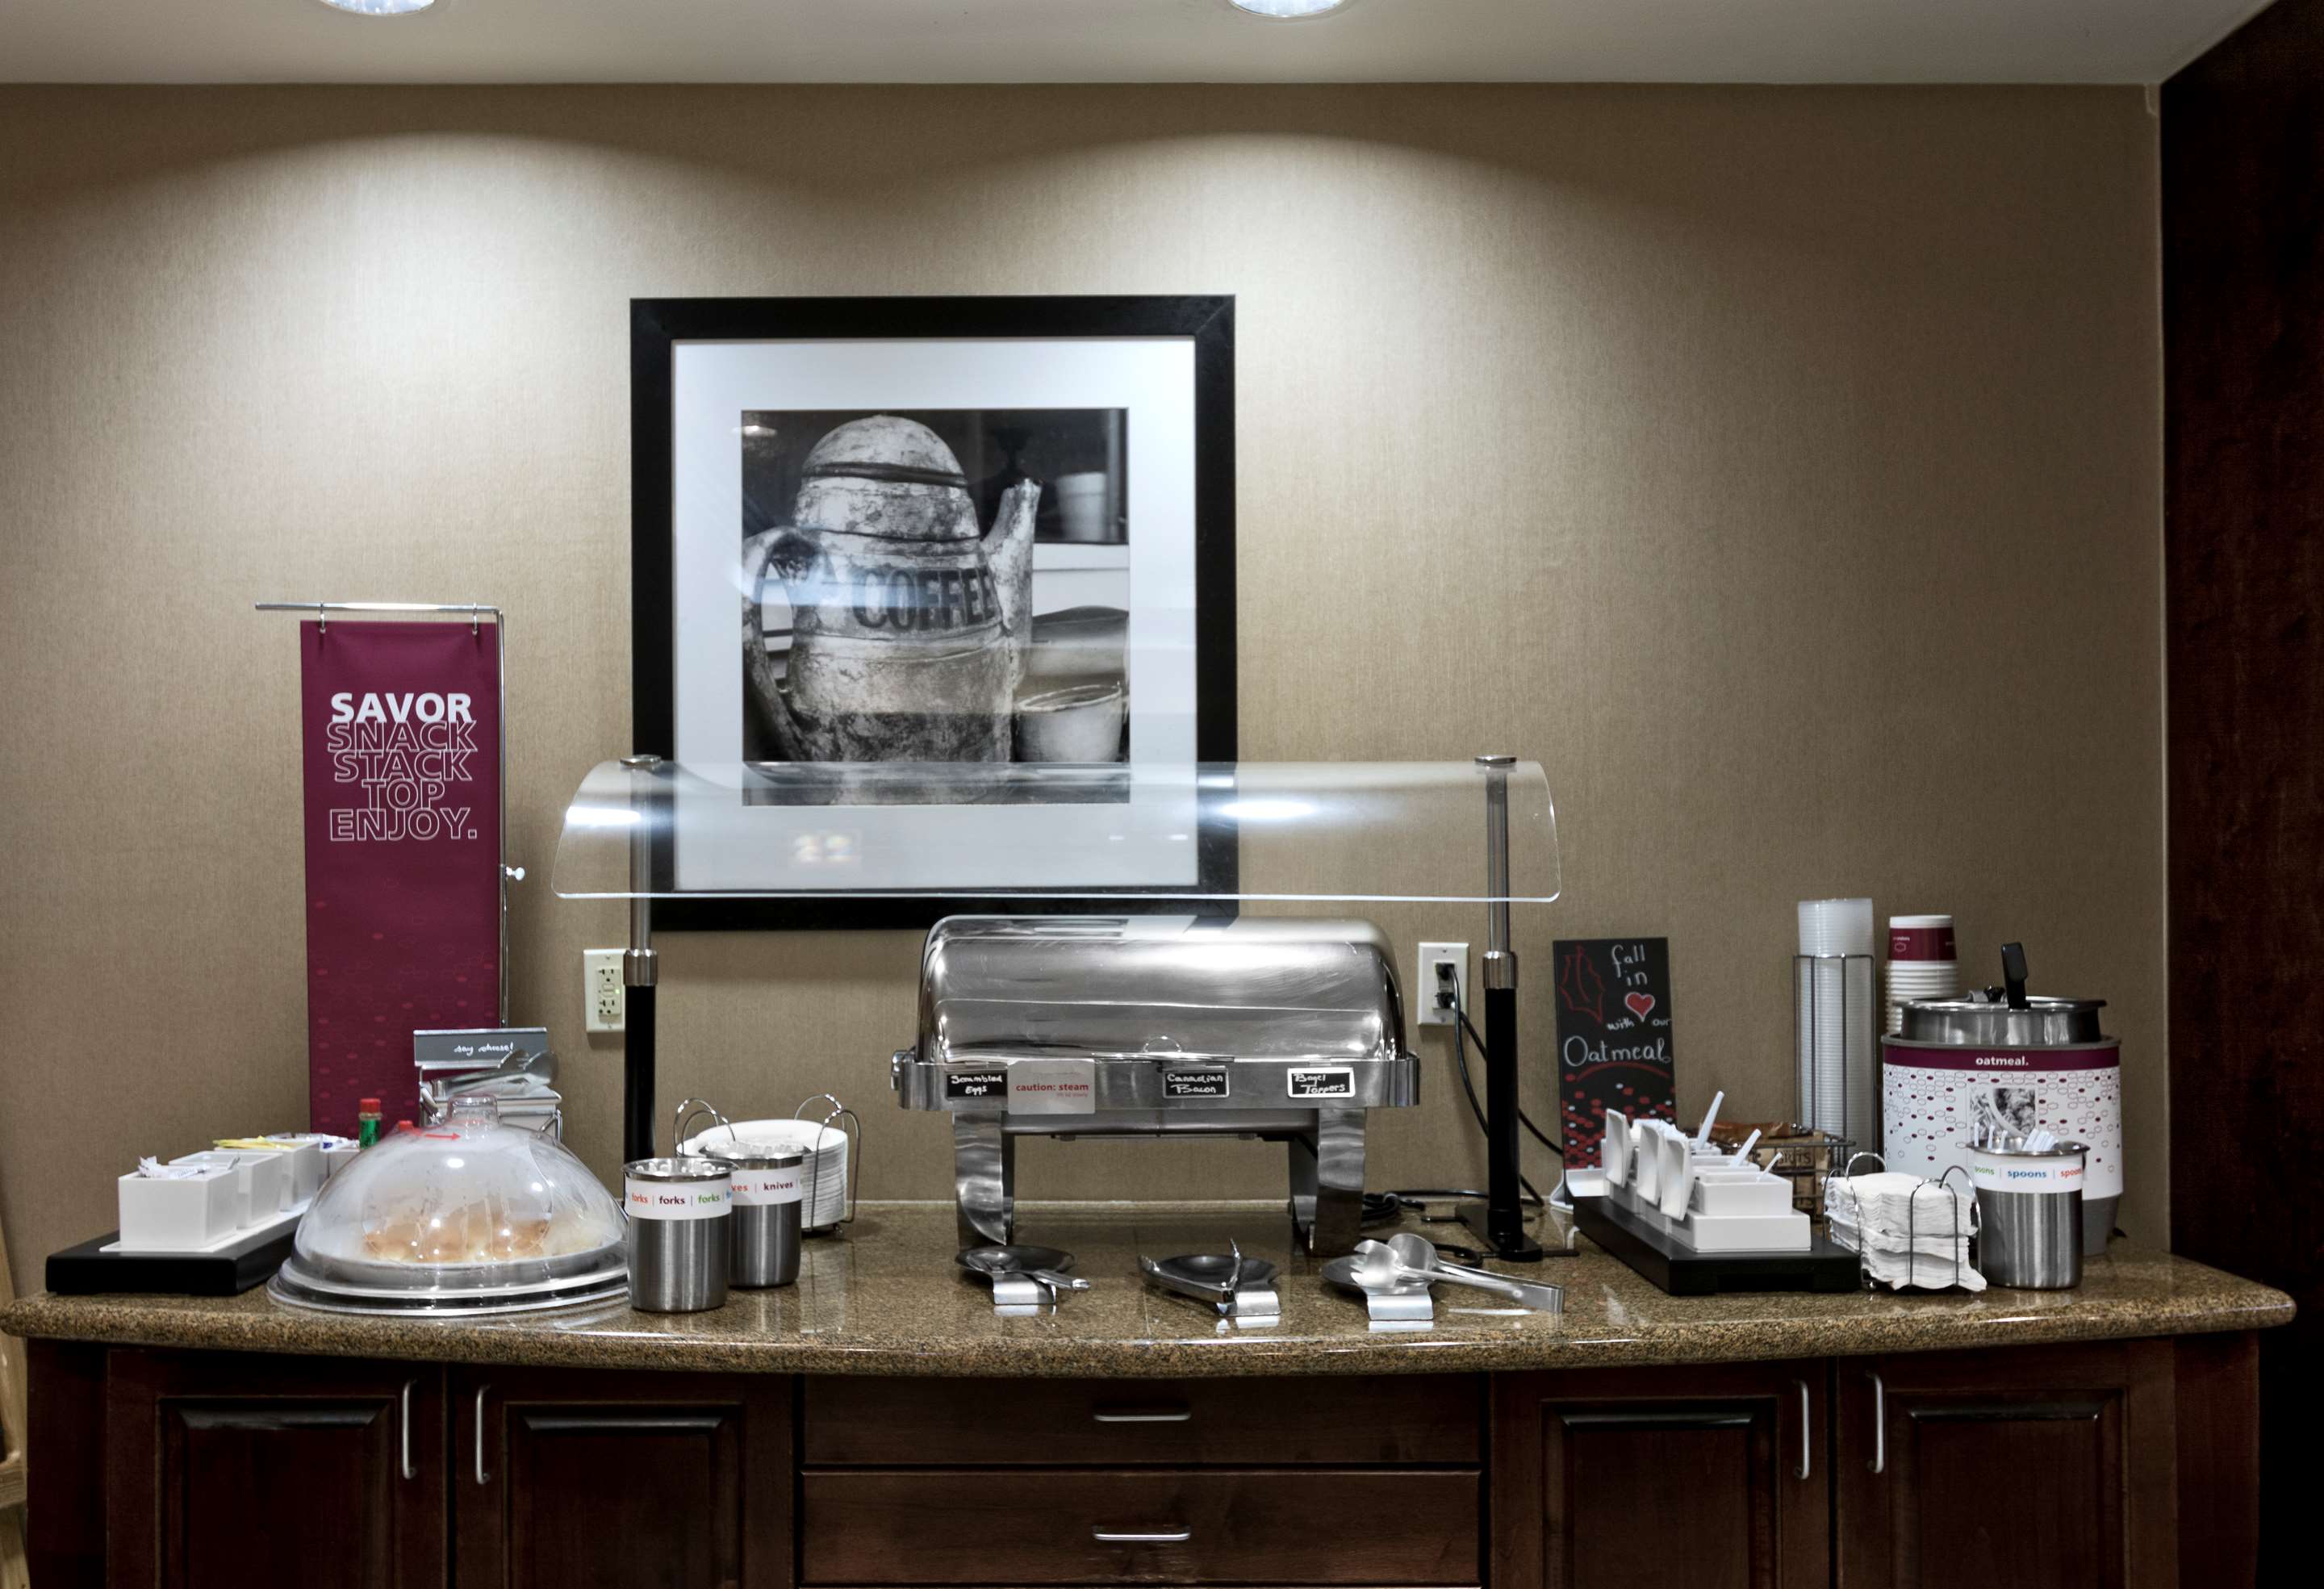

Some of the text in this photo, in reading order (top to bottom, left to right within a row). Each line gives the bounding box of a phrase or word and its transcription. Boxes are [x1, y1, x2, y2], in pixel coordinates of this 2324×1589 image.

[851, 563, 997, 630] COFFEE
[331, 692, 473, 724] SAVOR
[327, 720, 479, 753] SNACK
[333, 749, 473, 783] STACK
[362, 778, 445, 811] TOP
[329, 807, 478, 842] ENJOY.
[1611, 944, 1645, 977] fall
[1626, 970, 1648, 986] in
[1607, 1018, 1672, 1030] with our
[1564, 1035, 1671, 1067] Oatmeal
[1975, 1056, 2029, 1065] oatmeal.
[1167, 1073, 1223, 1083] Canadian
[1170, 1084, 1216, 1093] Bacon
[764, 1181, 793, 1190] knives
[2008, 1170, 2047, 1179] spoons
[2060, 1168, 2083, 1178] spoon
[659, 1195, 685, 1205] forks
[697, 1194, 720, 1203] forks
